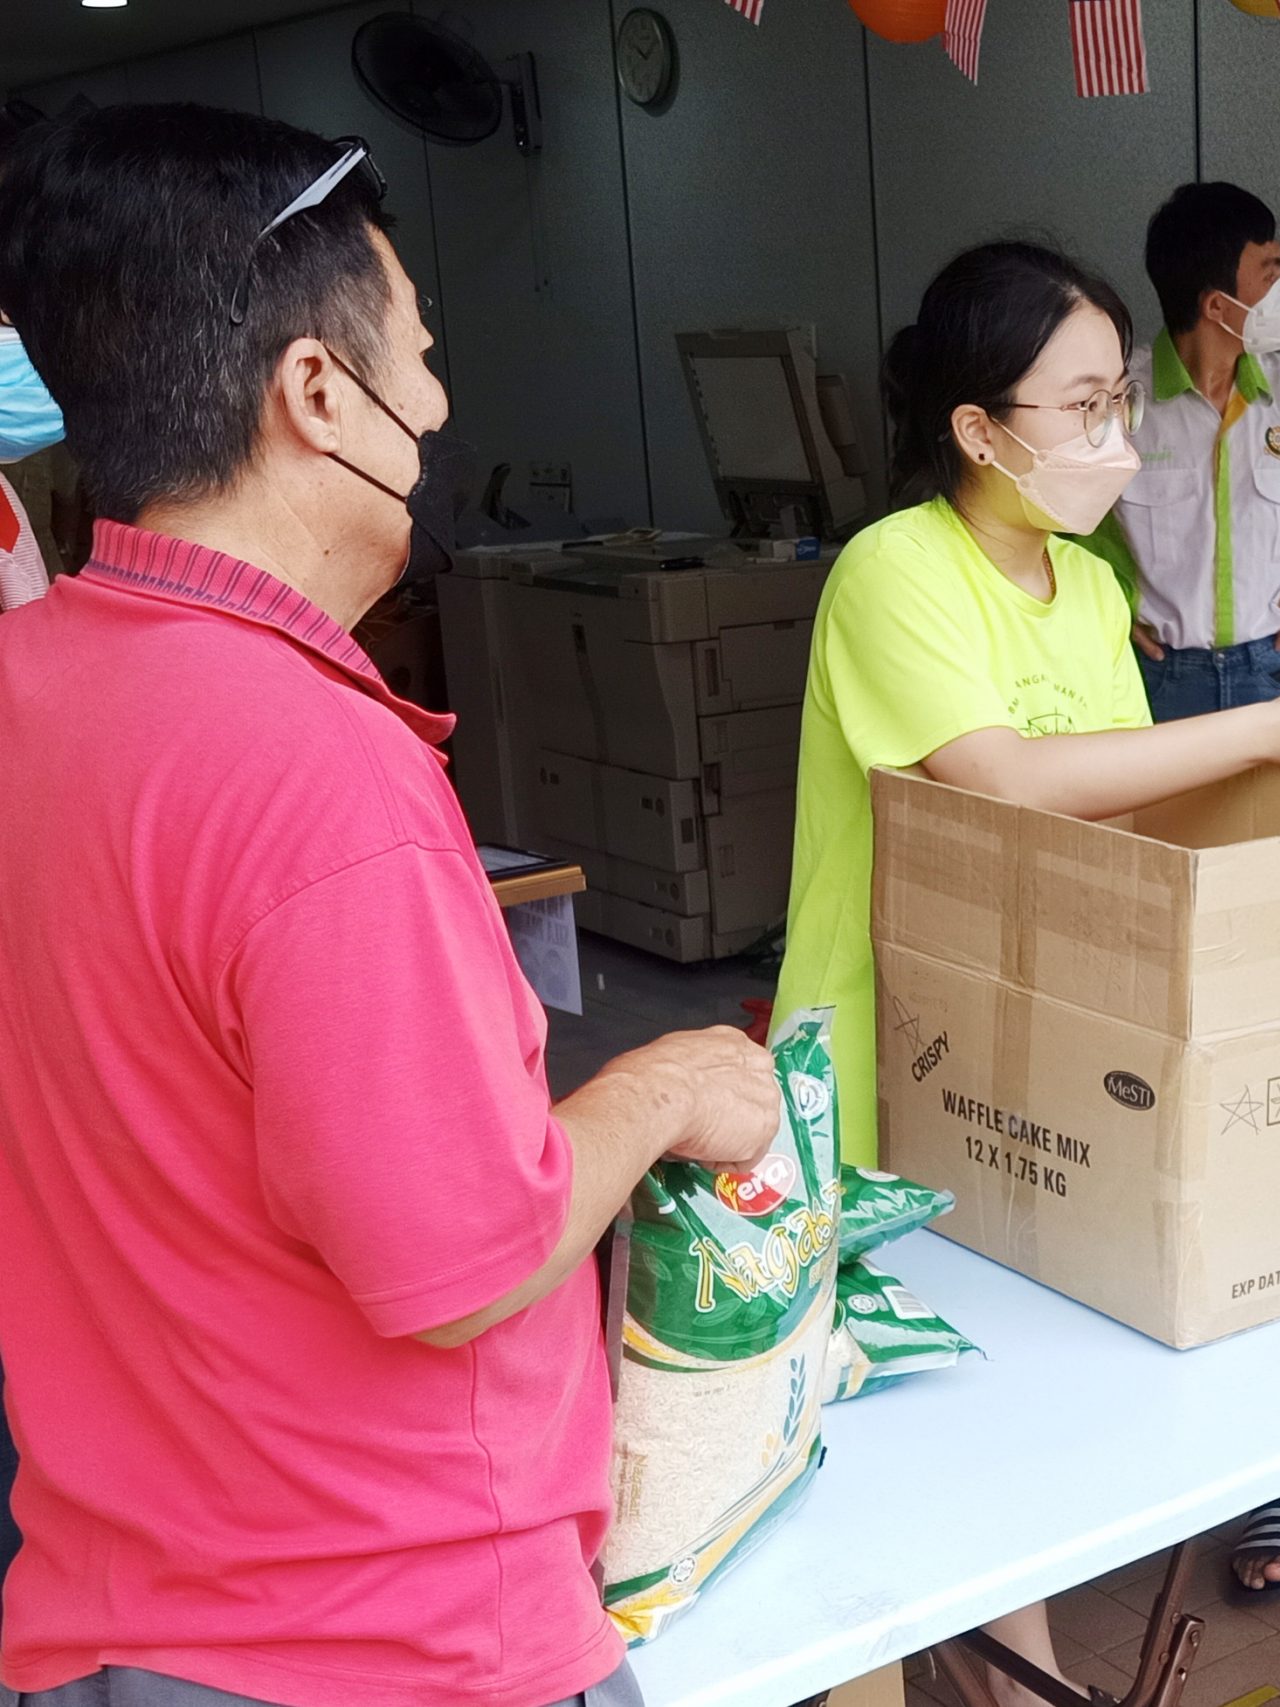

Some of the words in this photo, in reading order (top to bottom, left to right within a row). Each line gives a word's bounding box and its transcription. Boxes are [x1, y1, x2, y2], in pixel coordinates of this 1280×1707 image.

[911, 1031, 950, 1083] CRISPY
[1107, 1076, 1151, 1107] MeSTI
[942, 1088, 1003, 1134] WAFFLE
[1008, 1115, 1051, 1152] CAKE
[1057, 1133, 1091, 1168] MIX
[966, 1136, 983, 1164] 12
[988, 1144, 999, 1170] X
[1005, 1152, 1038, 1186] 1.75
[1044, 1166, 1067, 1197] KG
[1231, 1279, 1255, 1299] EXP
